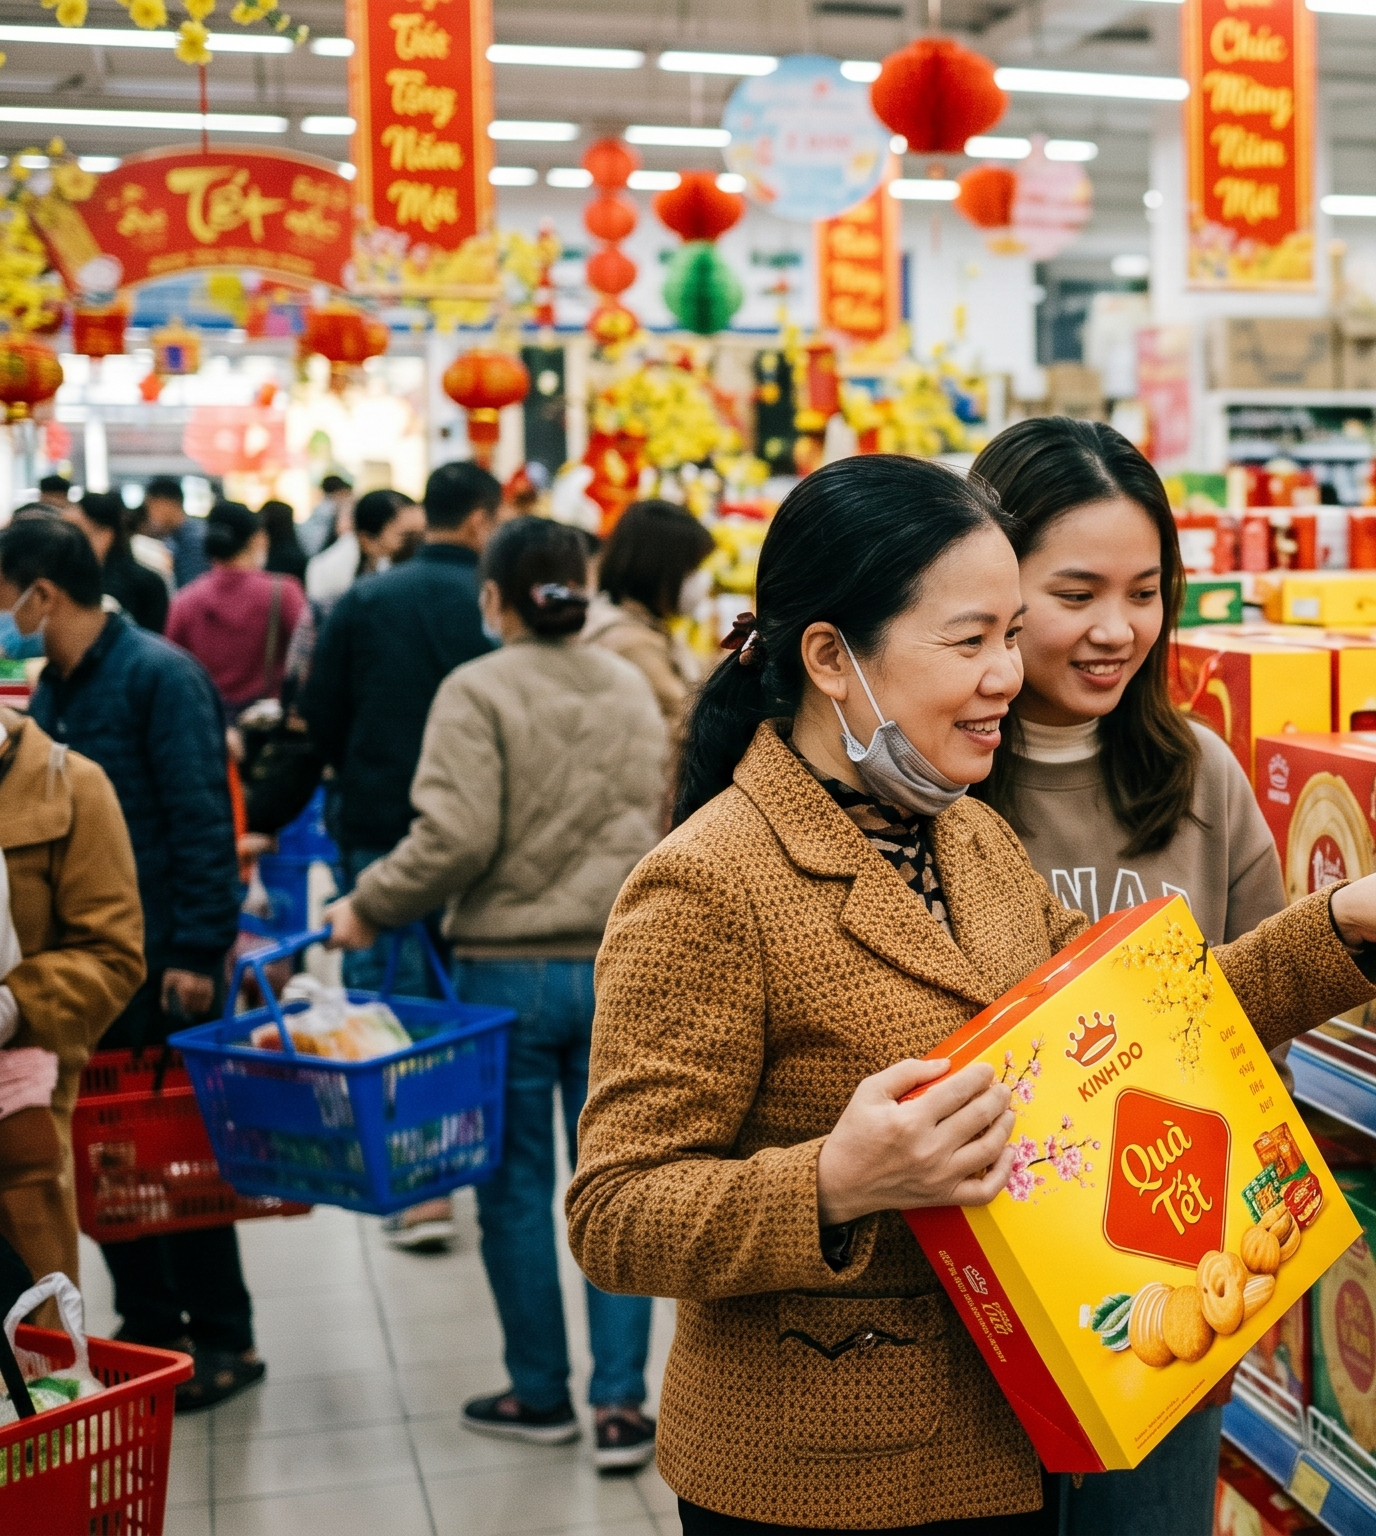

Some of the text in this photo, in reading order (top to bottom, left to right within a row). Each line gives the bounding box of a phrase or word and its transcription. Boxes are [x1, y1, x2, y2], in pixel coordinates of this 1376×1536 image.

[165, 165, 285, 243] Tết
[1078, 1042, 1143, 1102] KINH DO
[1120, 1120, 1192, 1195] Quà
[1152, 1169, 1212, 1235] Tết
